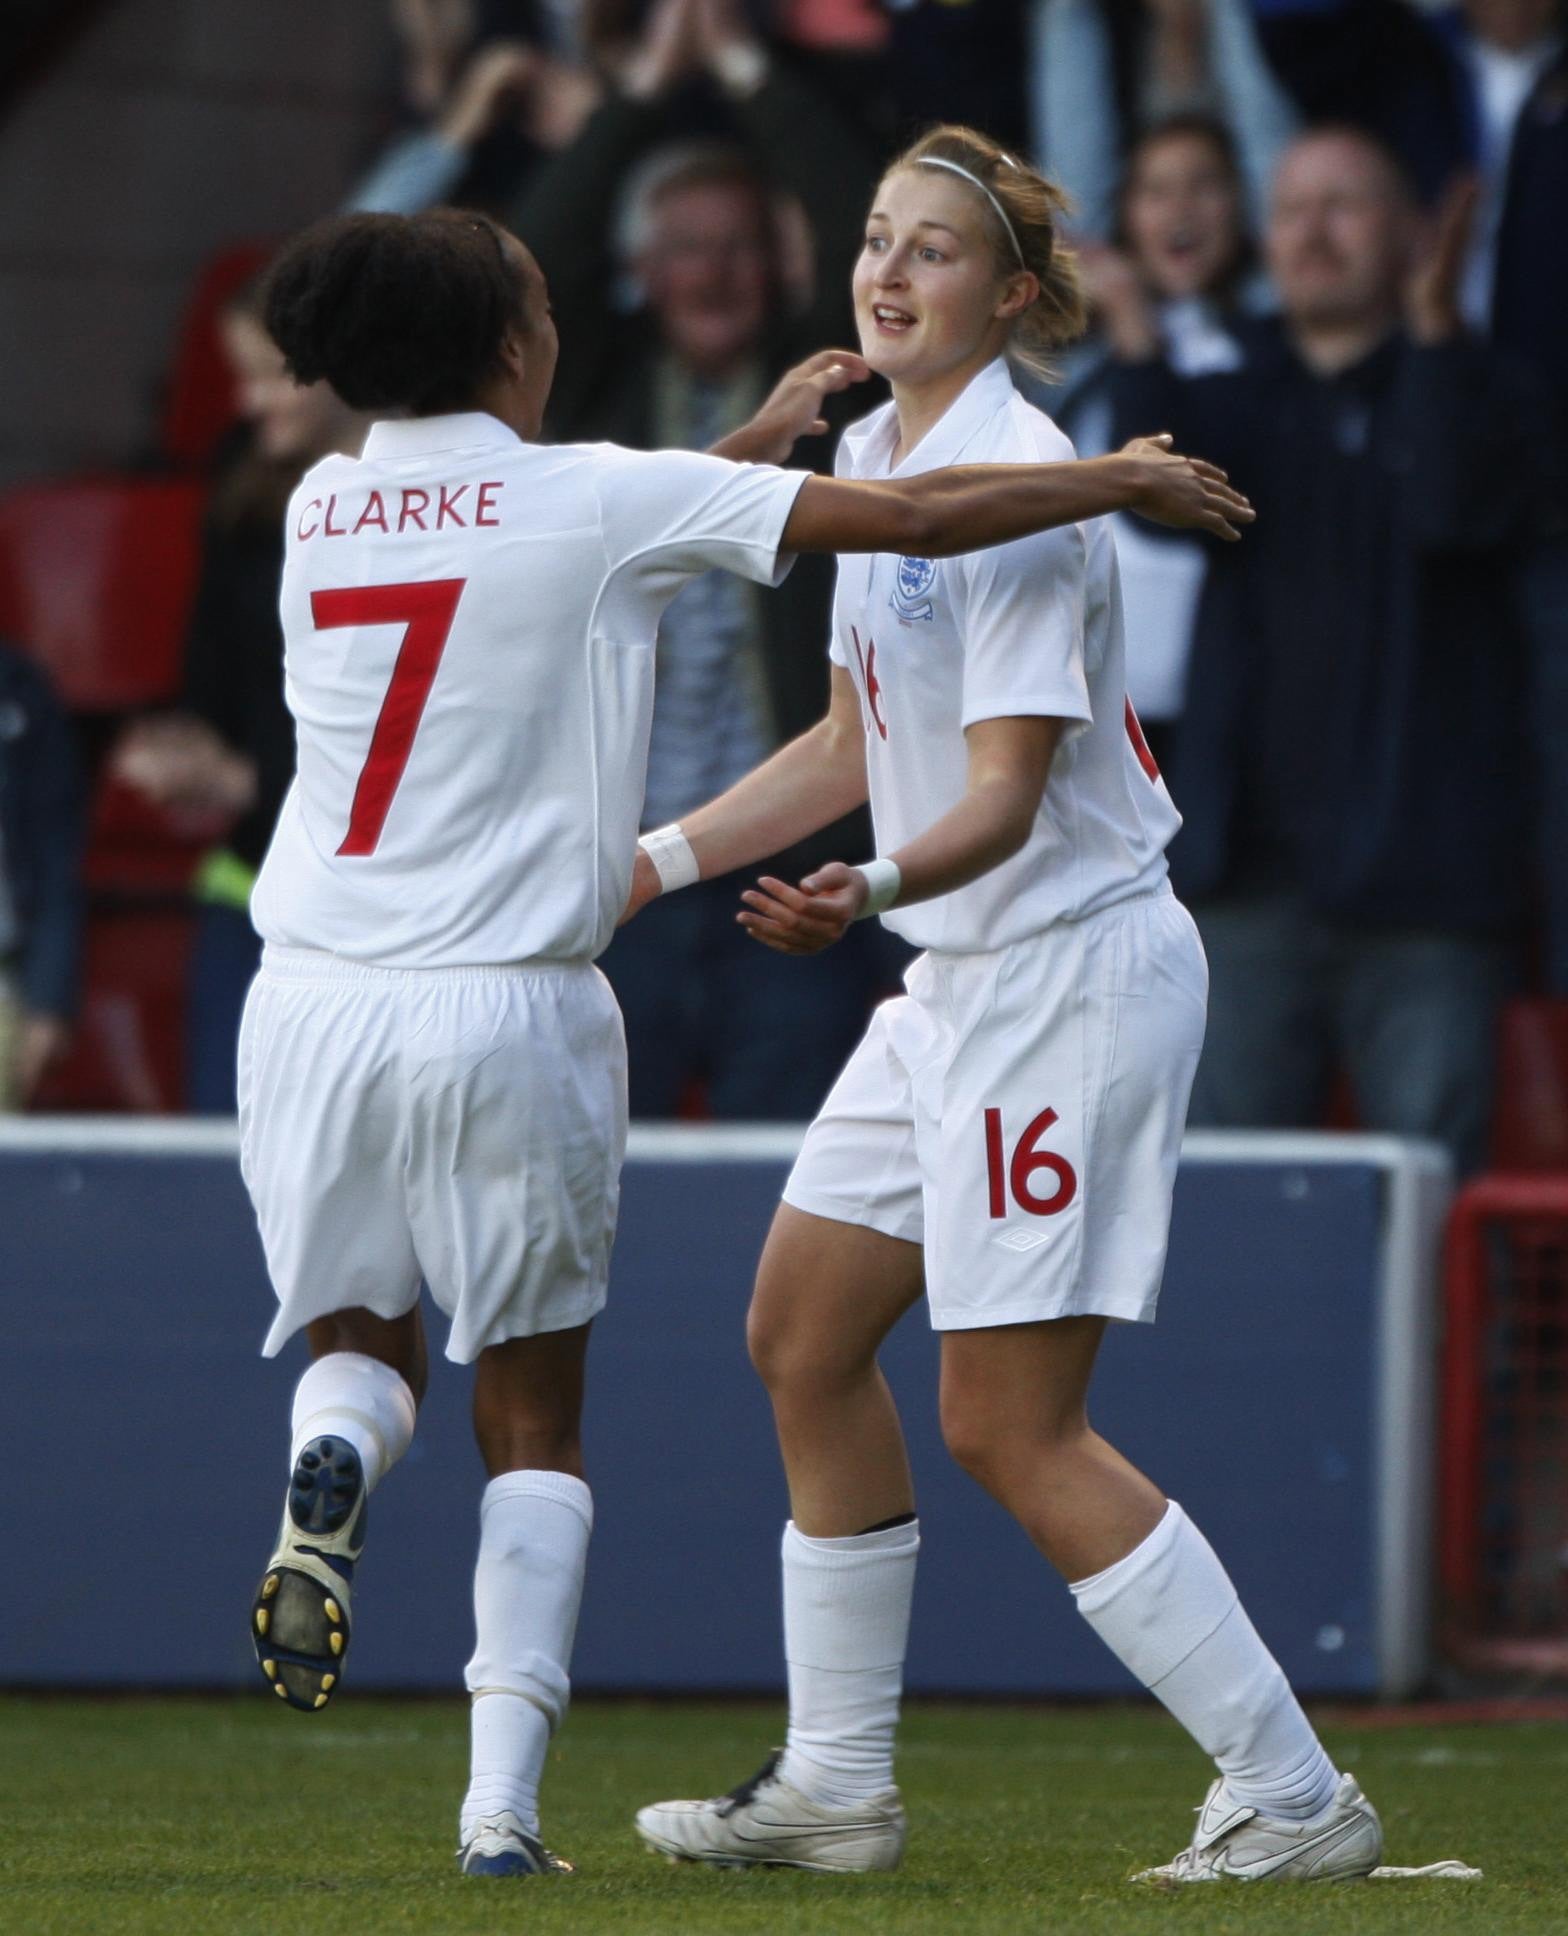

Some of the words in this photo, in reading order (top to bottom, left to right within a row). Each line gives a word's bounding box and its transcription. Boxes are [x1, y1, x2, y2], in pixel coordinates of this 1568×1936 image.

[297, 482, 504, 542] CLARKE
[310, 577, 468, 857] 7
[984, 1106, 1077, 1219] 16
